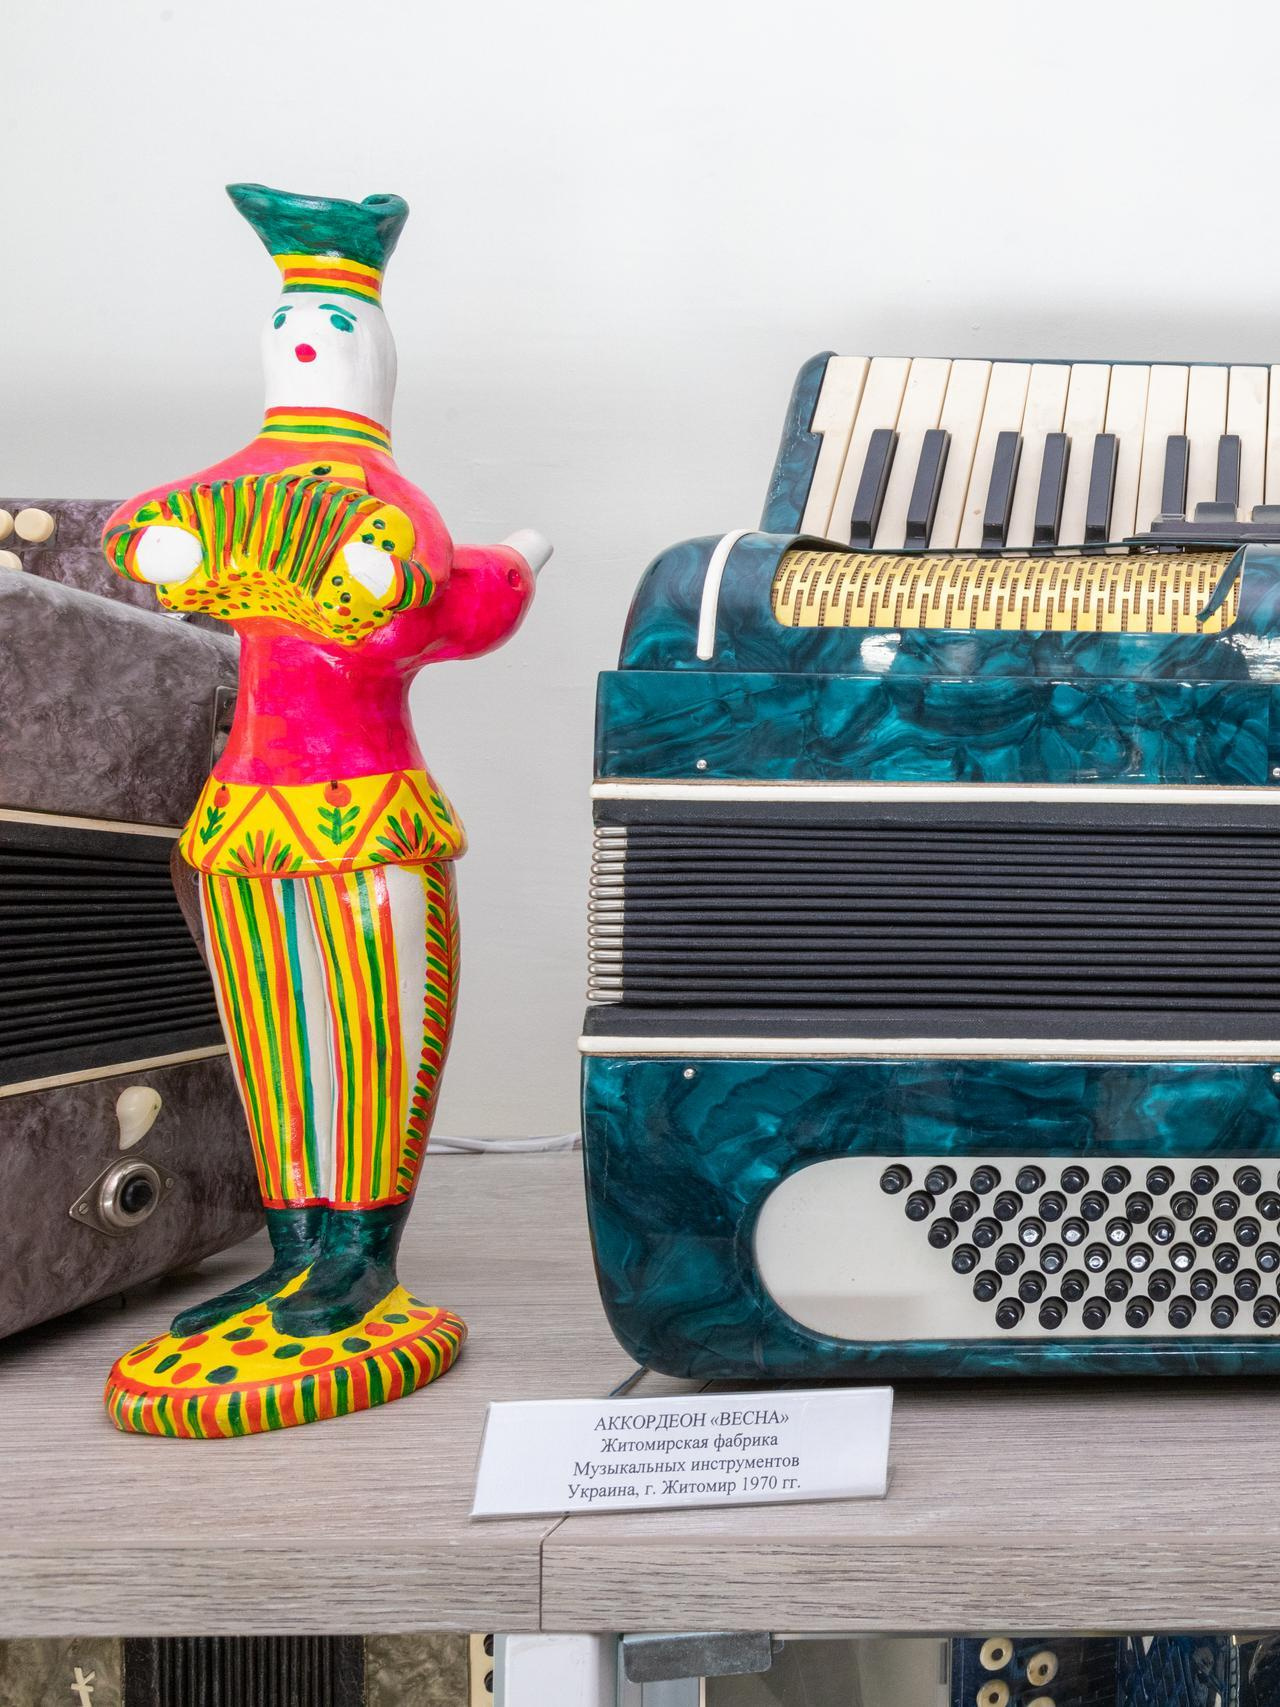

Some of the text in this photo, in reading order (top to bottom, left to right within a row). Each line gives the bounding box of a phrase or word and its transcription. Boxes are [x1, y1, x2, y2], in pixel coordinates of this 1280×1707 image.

[594, 1410, 789, 1431] АККОРДЕОН «ВЕСНА»
[600, 1432, 778, 1454] Житомирская фабрика
[573, 1456, 800, 1479] Музыкальных инструментов
[568, 1474, 801, 1502] Украина, г. Житомир 1970 гг.
